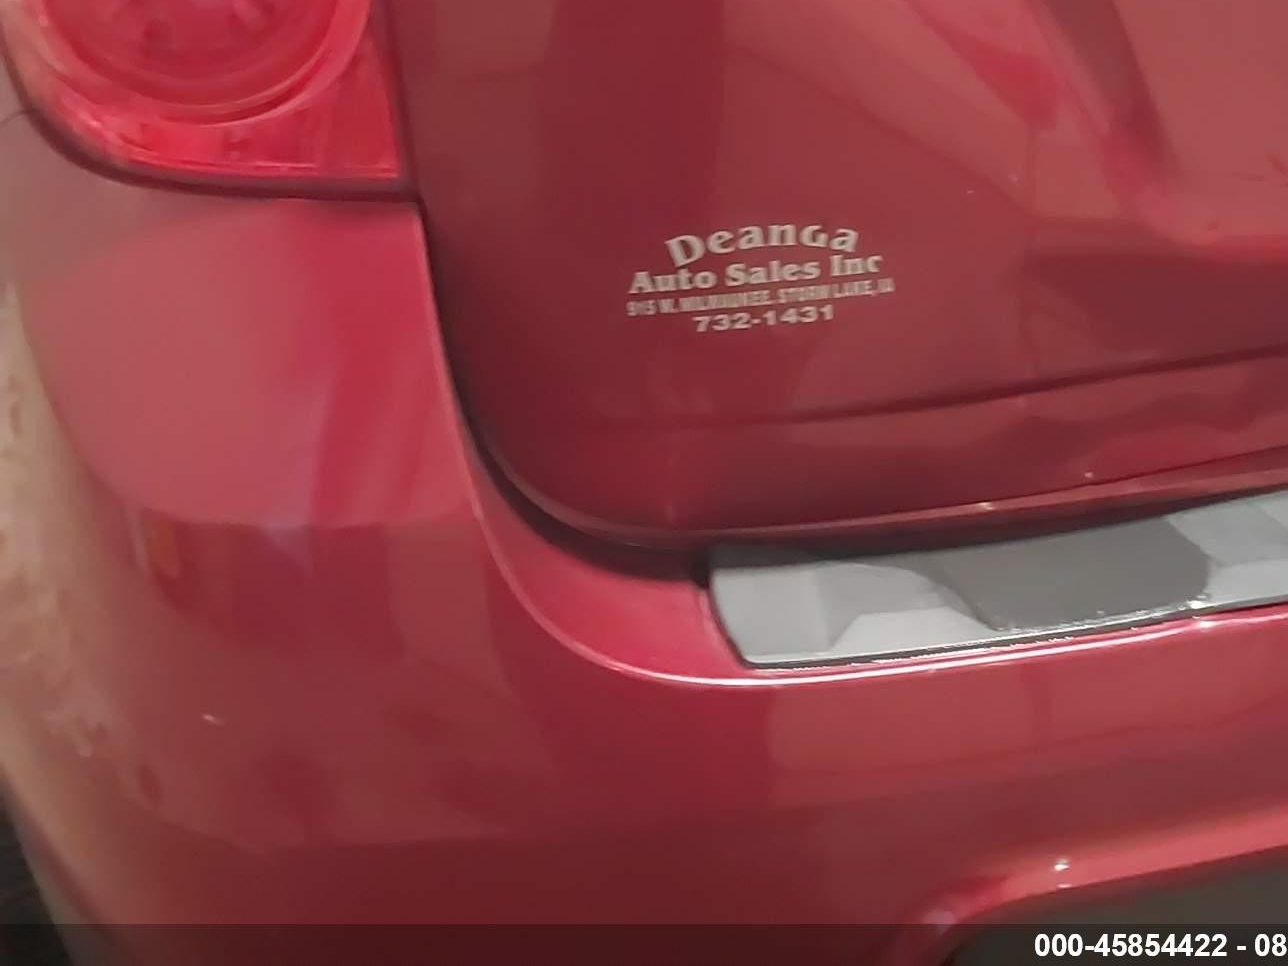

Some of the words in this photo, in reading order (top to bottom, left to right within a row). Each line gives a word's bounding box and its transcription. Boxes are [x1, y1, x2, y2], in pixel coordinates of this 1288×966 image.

[628, 269, 717, 294] Auto
[724, 260, 820, 286] Sales
[829, 254, 883, 276] Inc
[692, 304, 834, 332] 732-1431
